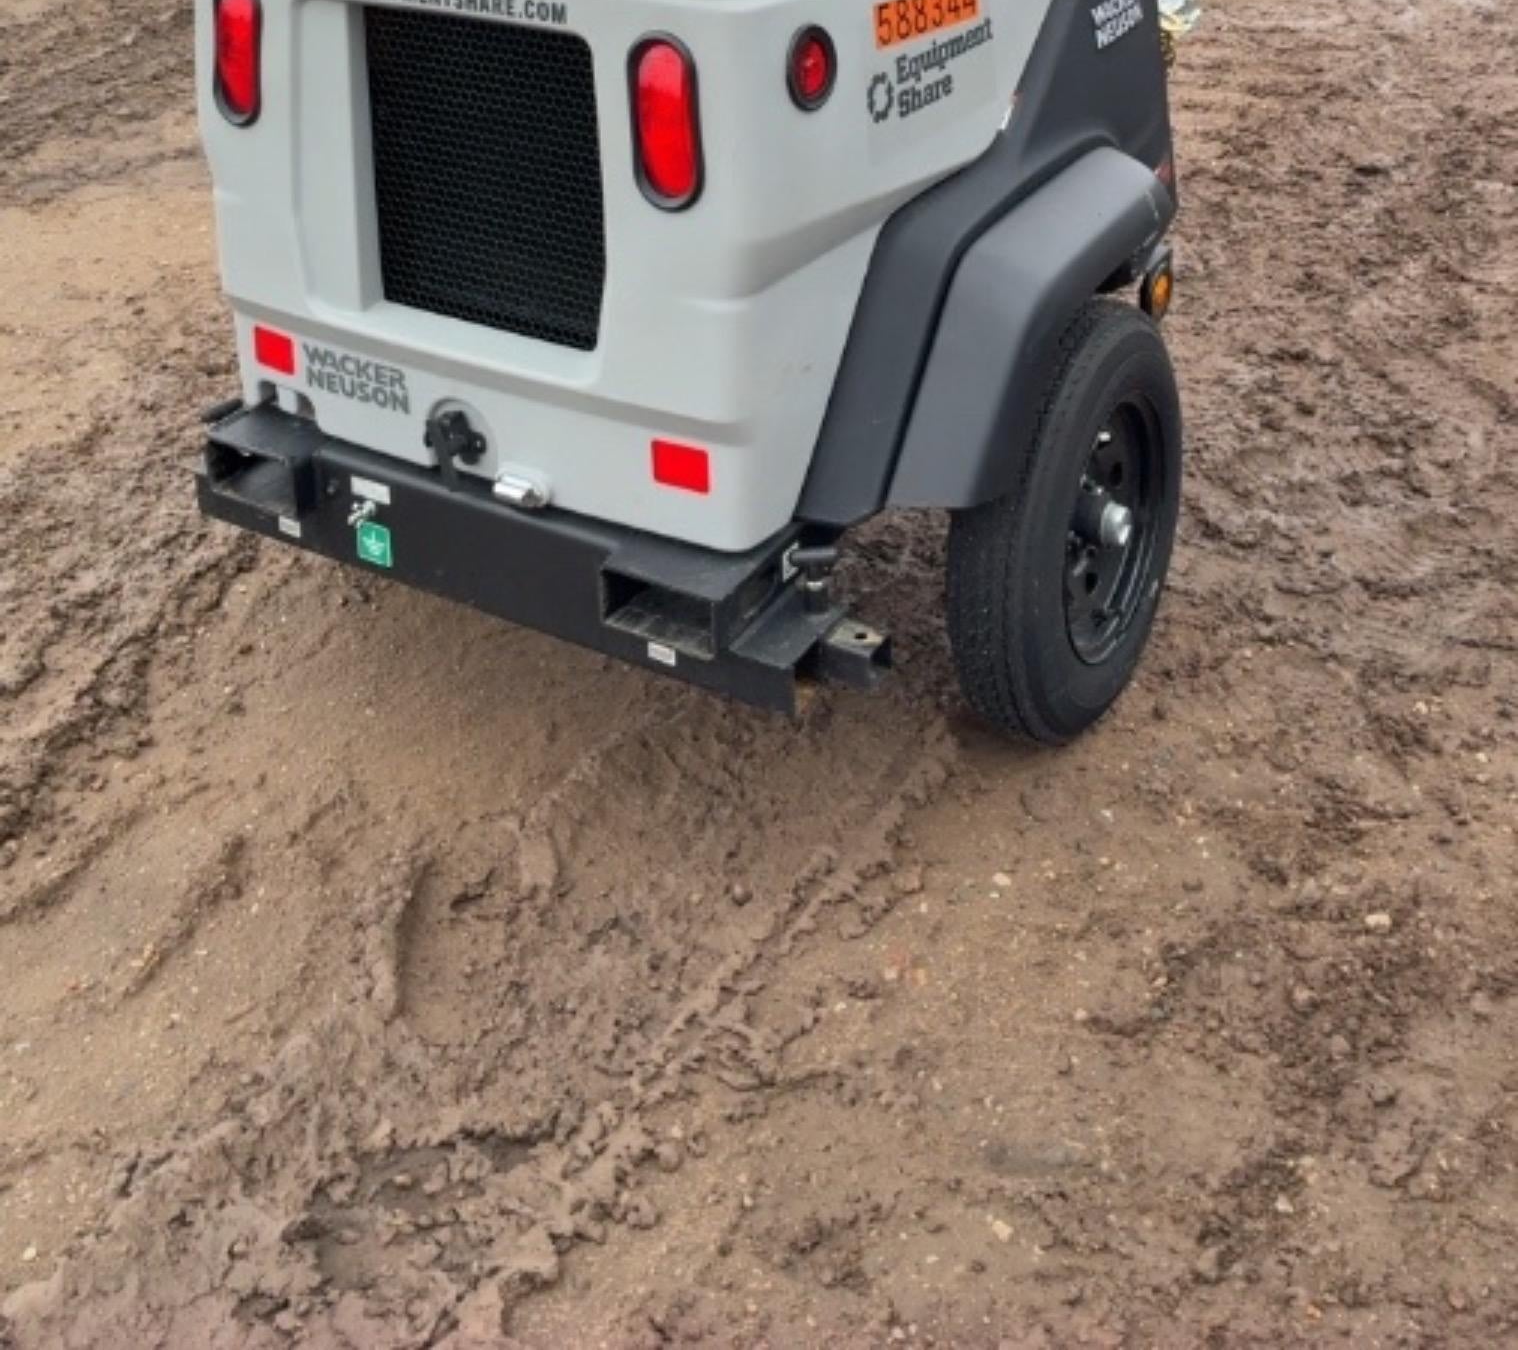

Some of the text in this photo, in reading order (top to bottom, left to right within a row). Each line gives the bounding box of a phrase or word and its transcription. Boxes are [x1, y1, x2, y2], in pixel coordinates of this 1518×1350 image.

[896, 17, 993, 84] Equipment
[897, 75, 953, 118] Share
[302, 341, 407, 391] WACKER
[306, 365, 410, 415] NEUSON
